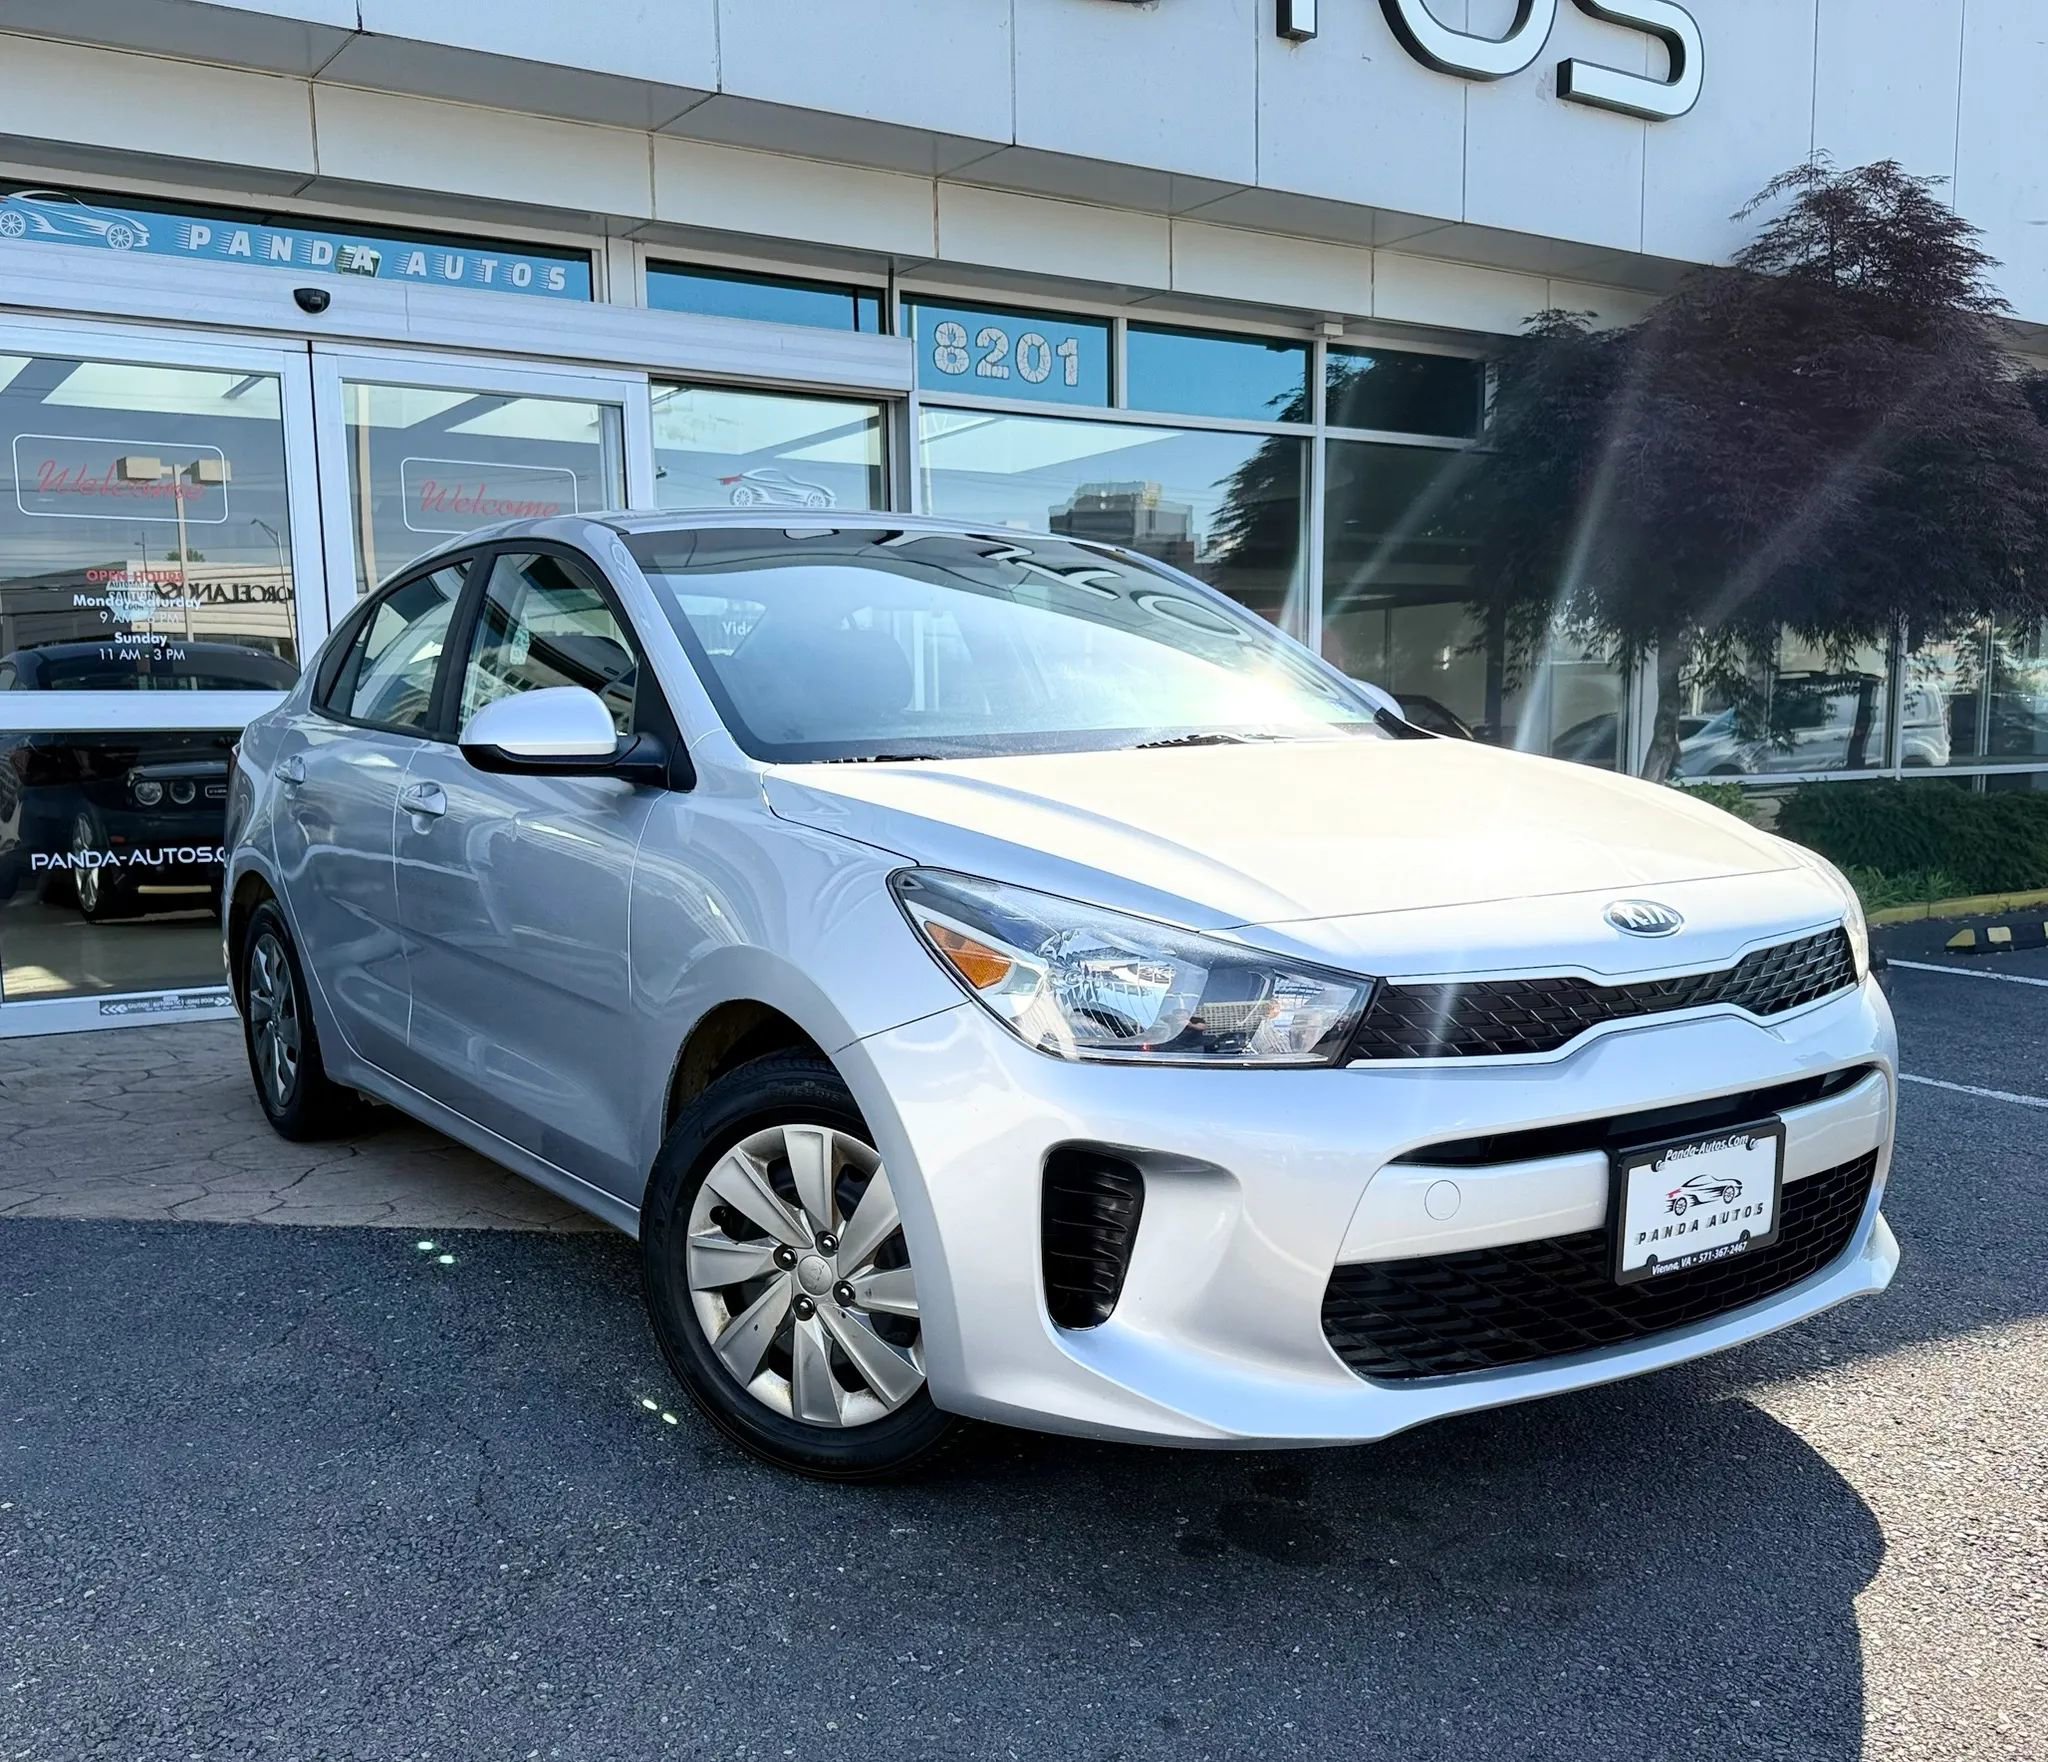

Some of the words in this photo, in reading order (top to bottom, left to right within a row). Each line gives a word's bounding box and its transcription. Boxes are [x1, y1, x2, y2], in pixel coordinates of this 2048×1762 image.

[188, 224, 374, 271] PANDA
[405, 251, 566, 291] AUTOS
[933, 320, 1079, 388] 8201
[419, 478, 561, 517] Welcome
[86, 569, 128, 583] OPEN
[134, 571, 185, 585] HOURS
[99, 611, 108, 624] 9
[114, 631, 168, 647] Sunday
[99, 648, 114, 660] 11
[119, 648, 141, 660] AM
[153, 648, 162, 660] 3
[166, 649, 186, 661] PM
[1610, 902, 1679, 929] KIA
[1665, 1134, 1749, 1163] Panda-Autos.Com
[1636, 1219, 1700, 1245] PANDA
[1708, 1202, 1764, 1228] AUTOS
[1681, 1256, 1692, 1268] VA
